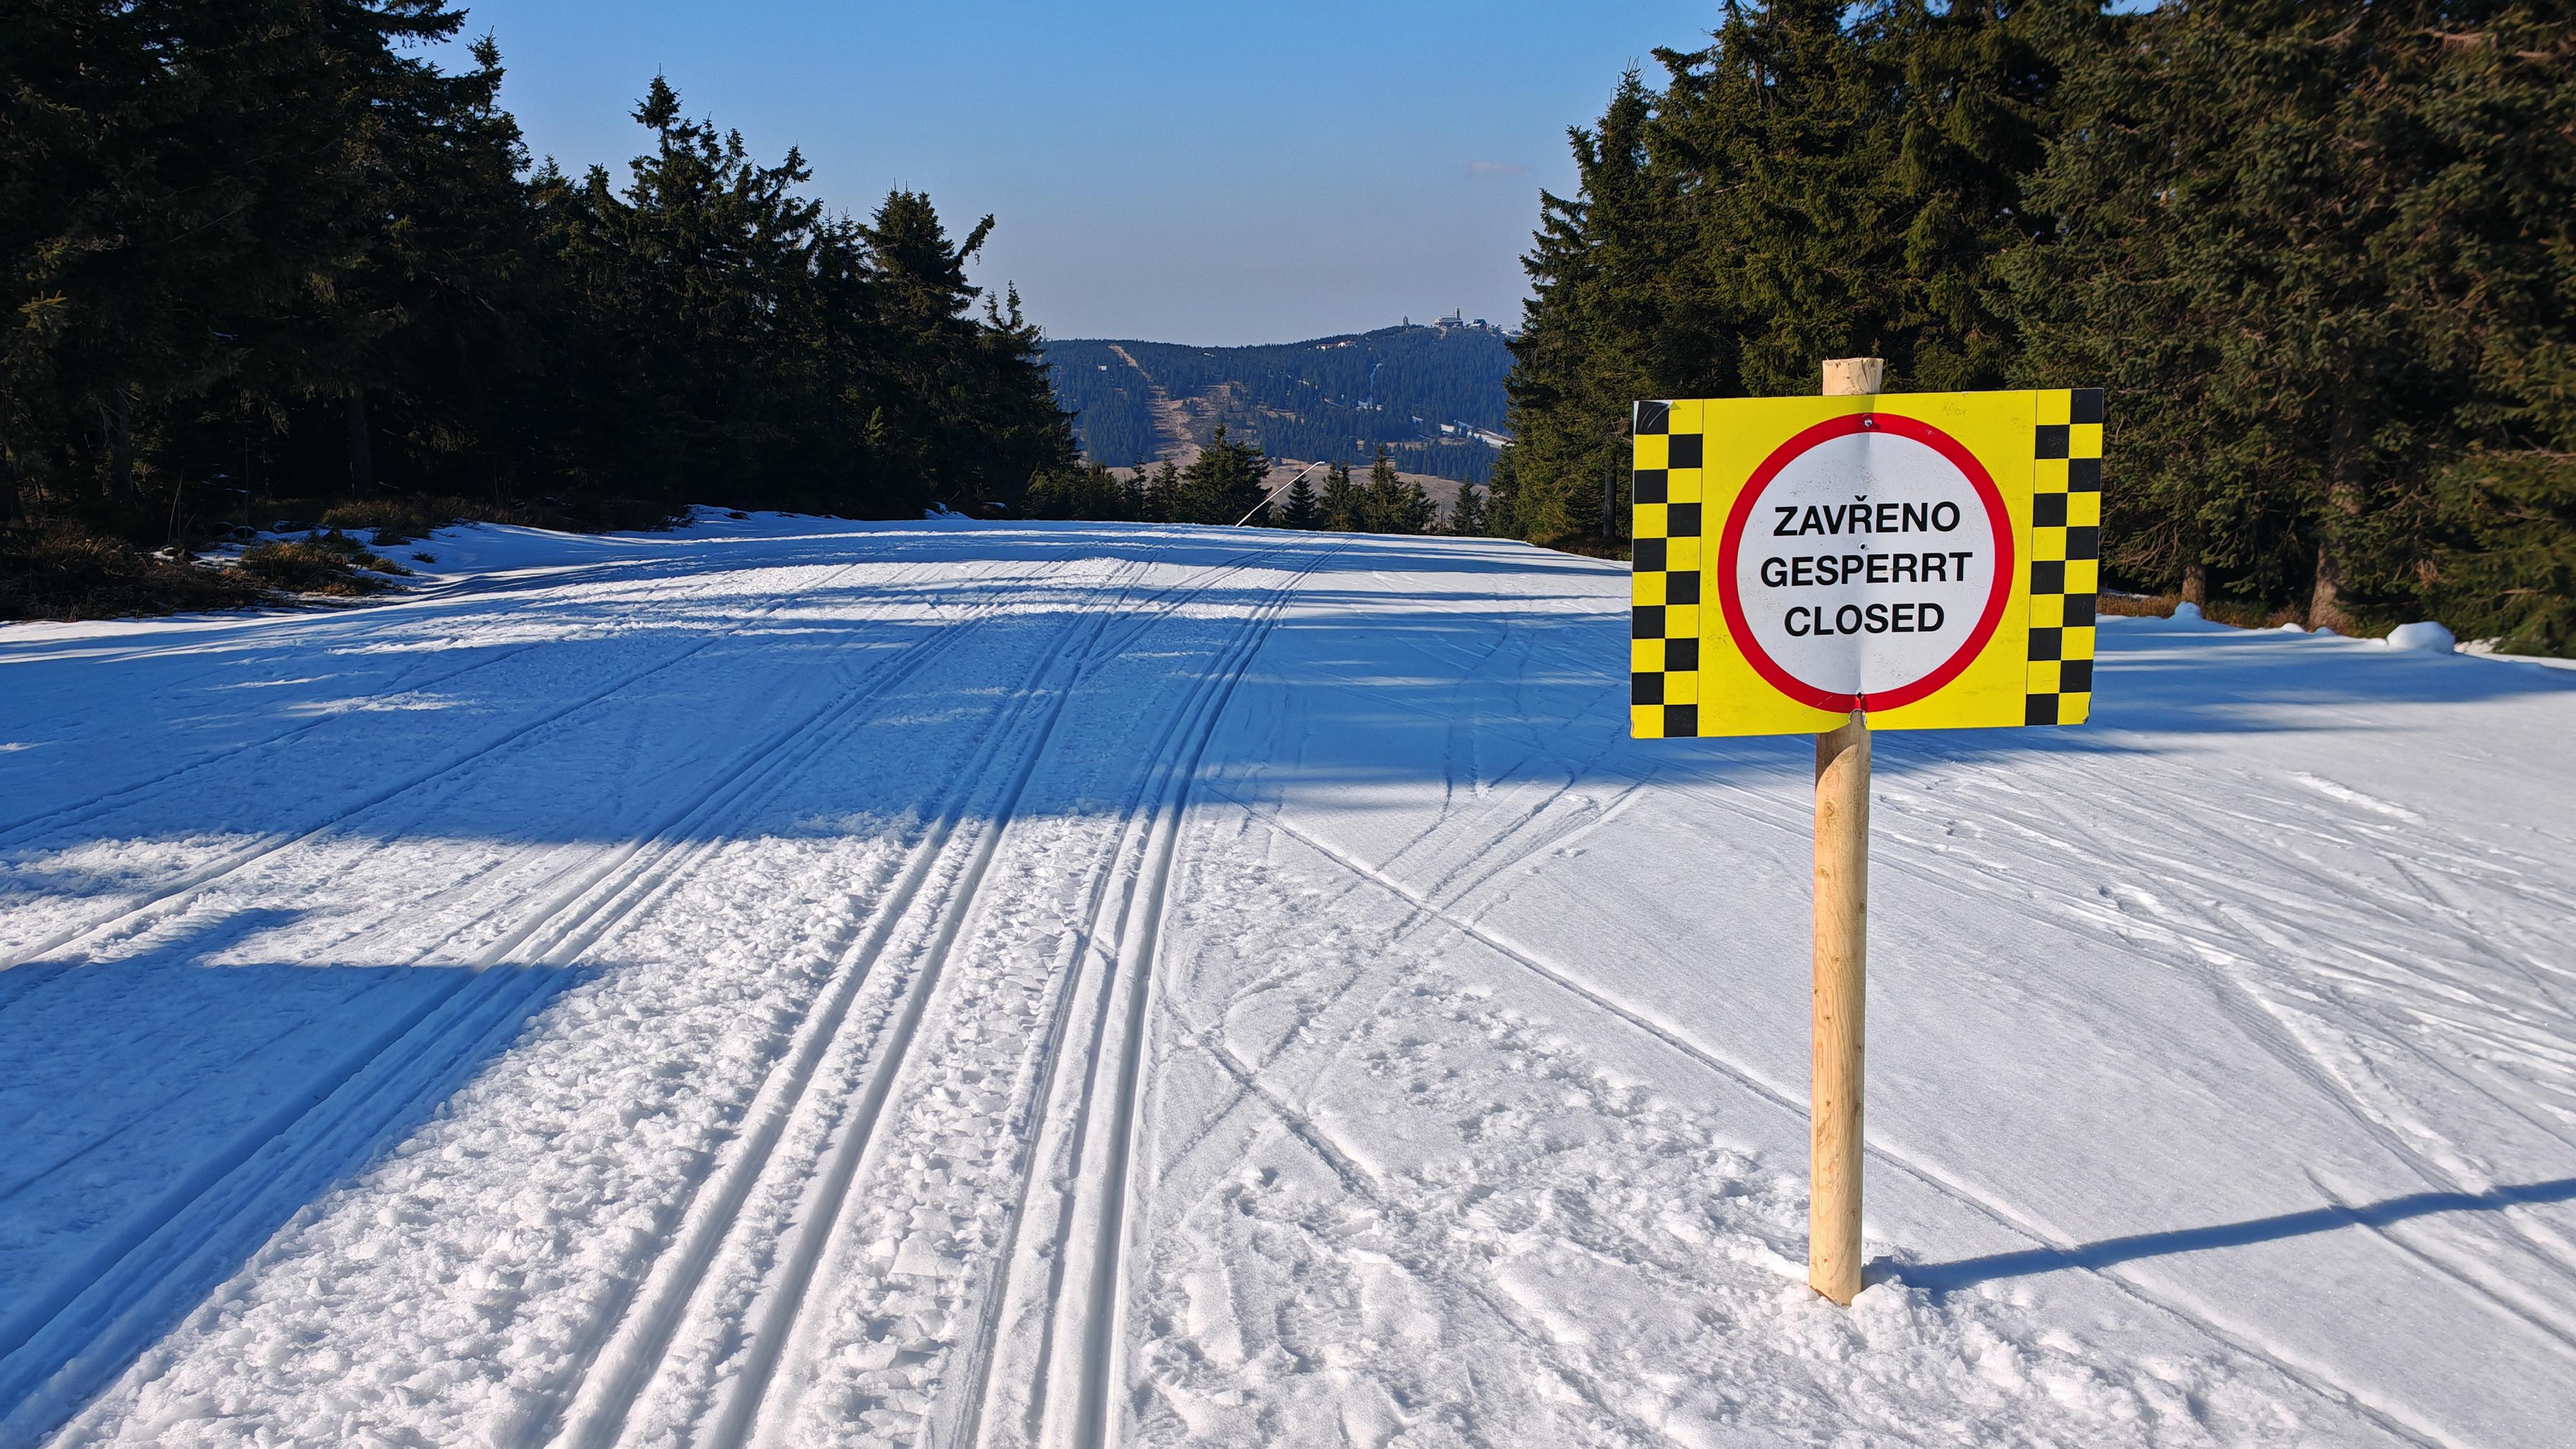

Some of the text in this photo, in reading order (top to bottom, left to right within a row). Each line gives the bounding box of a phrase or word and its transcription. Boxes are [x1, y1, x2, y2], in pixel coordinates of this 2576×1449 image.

[1773, 495, 1960, 536] ZAVŘENO
[1761, 551, 1973, 588] GESPERRT
[1784, 603, 1944, 637] CLOSED
